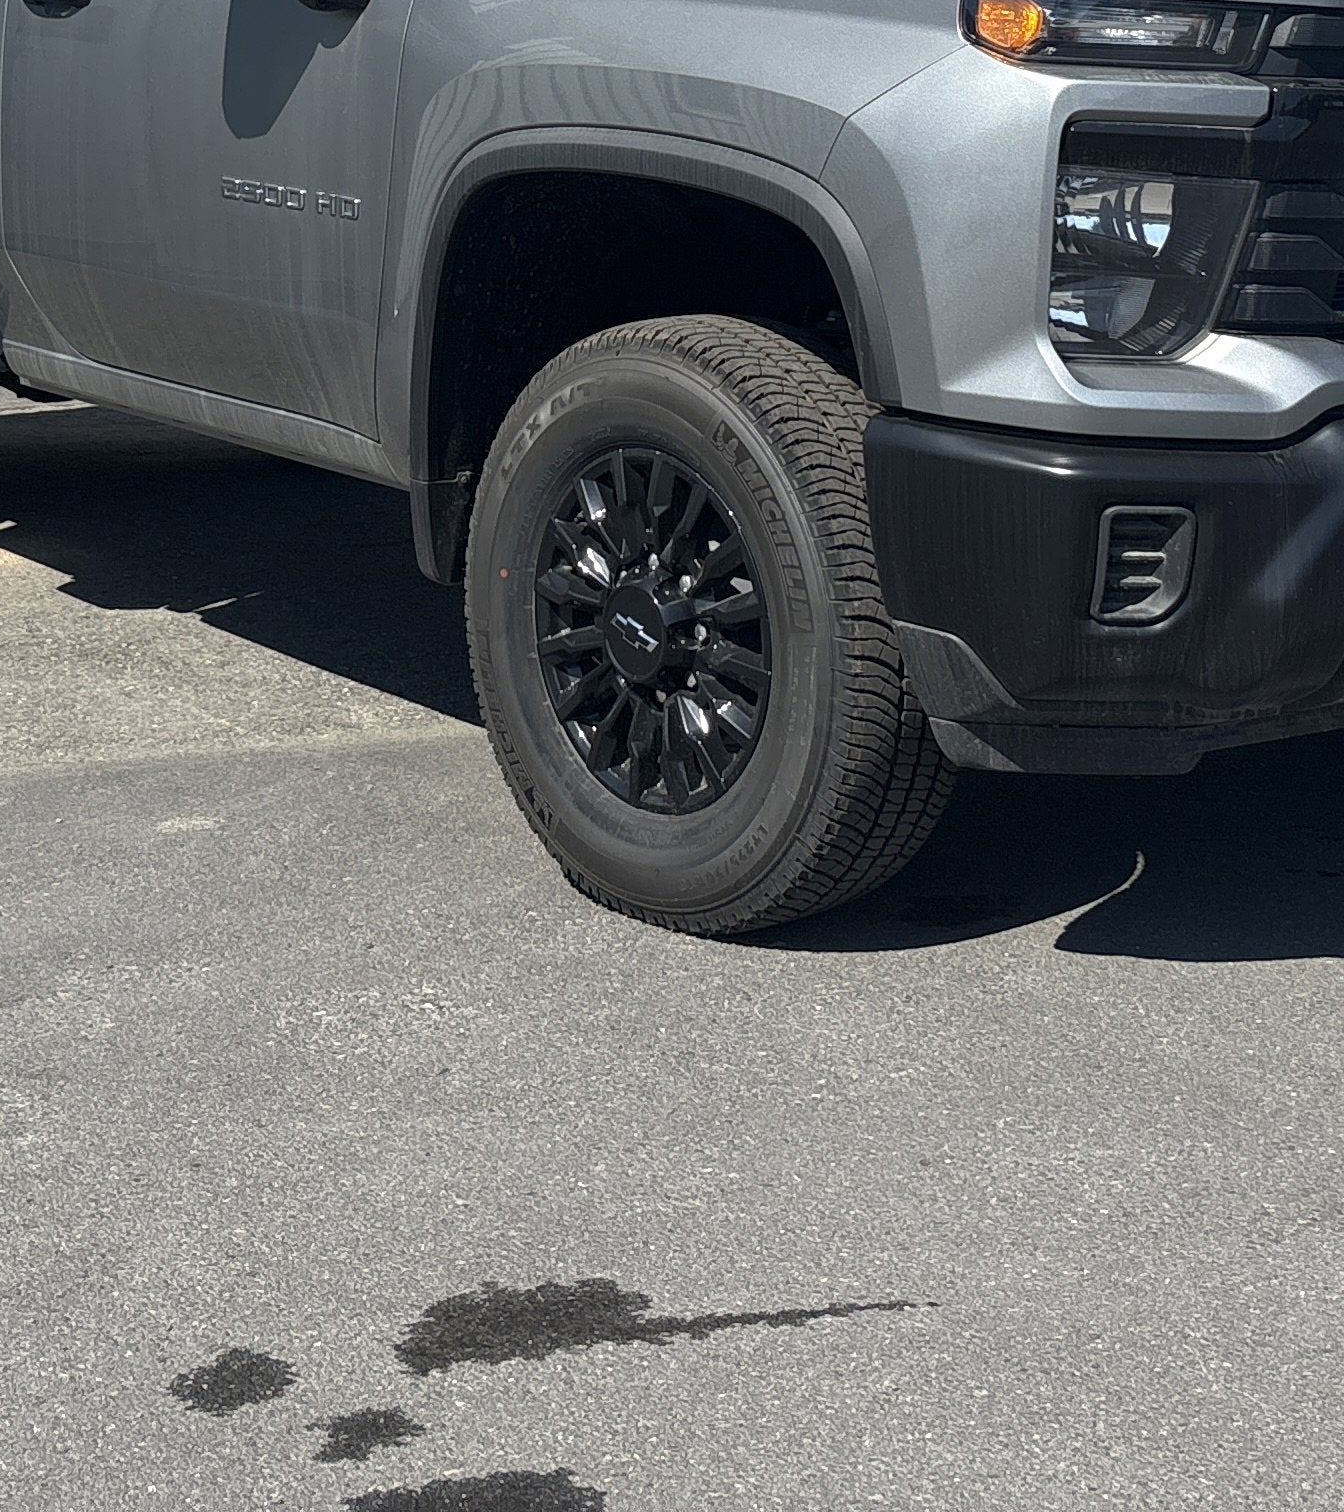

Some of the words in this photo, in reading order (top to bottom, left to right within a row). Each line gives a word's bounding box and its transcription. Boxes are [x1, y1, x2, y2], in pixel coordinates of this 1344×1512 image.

[221, 176, 307, 210] 2500
[316, 191, 361, 221] HD
[737, 457, 814, 633] MICHELIN
